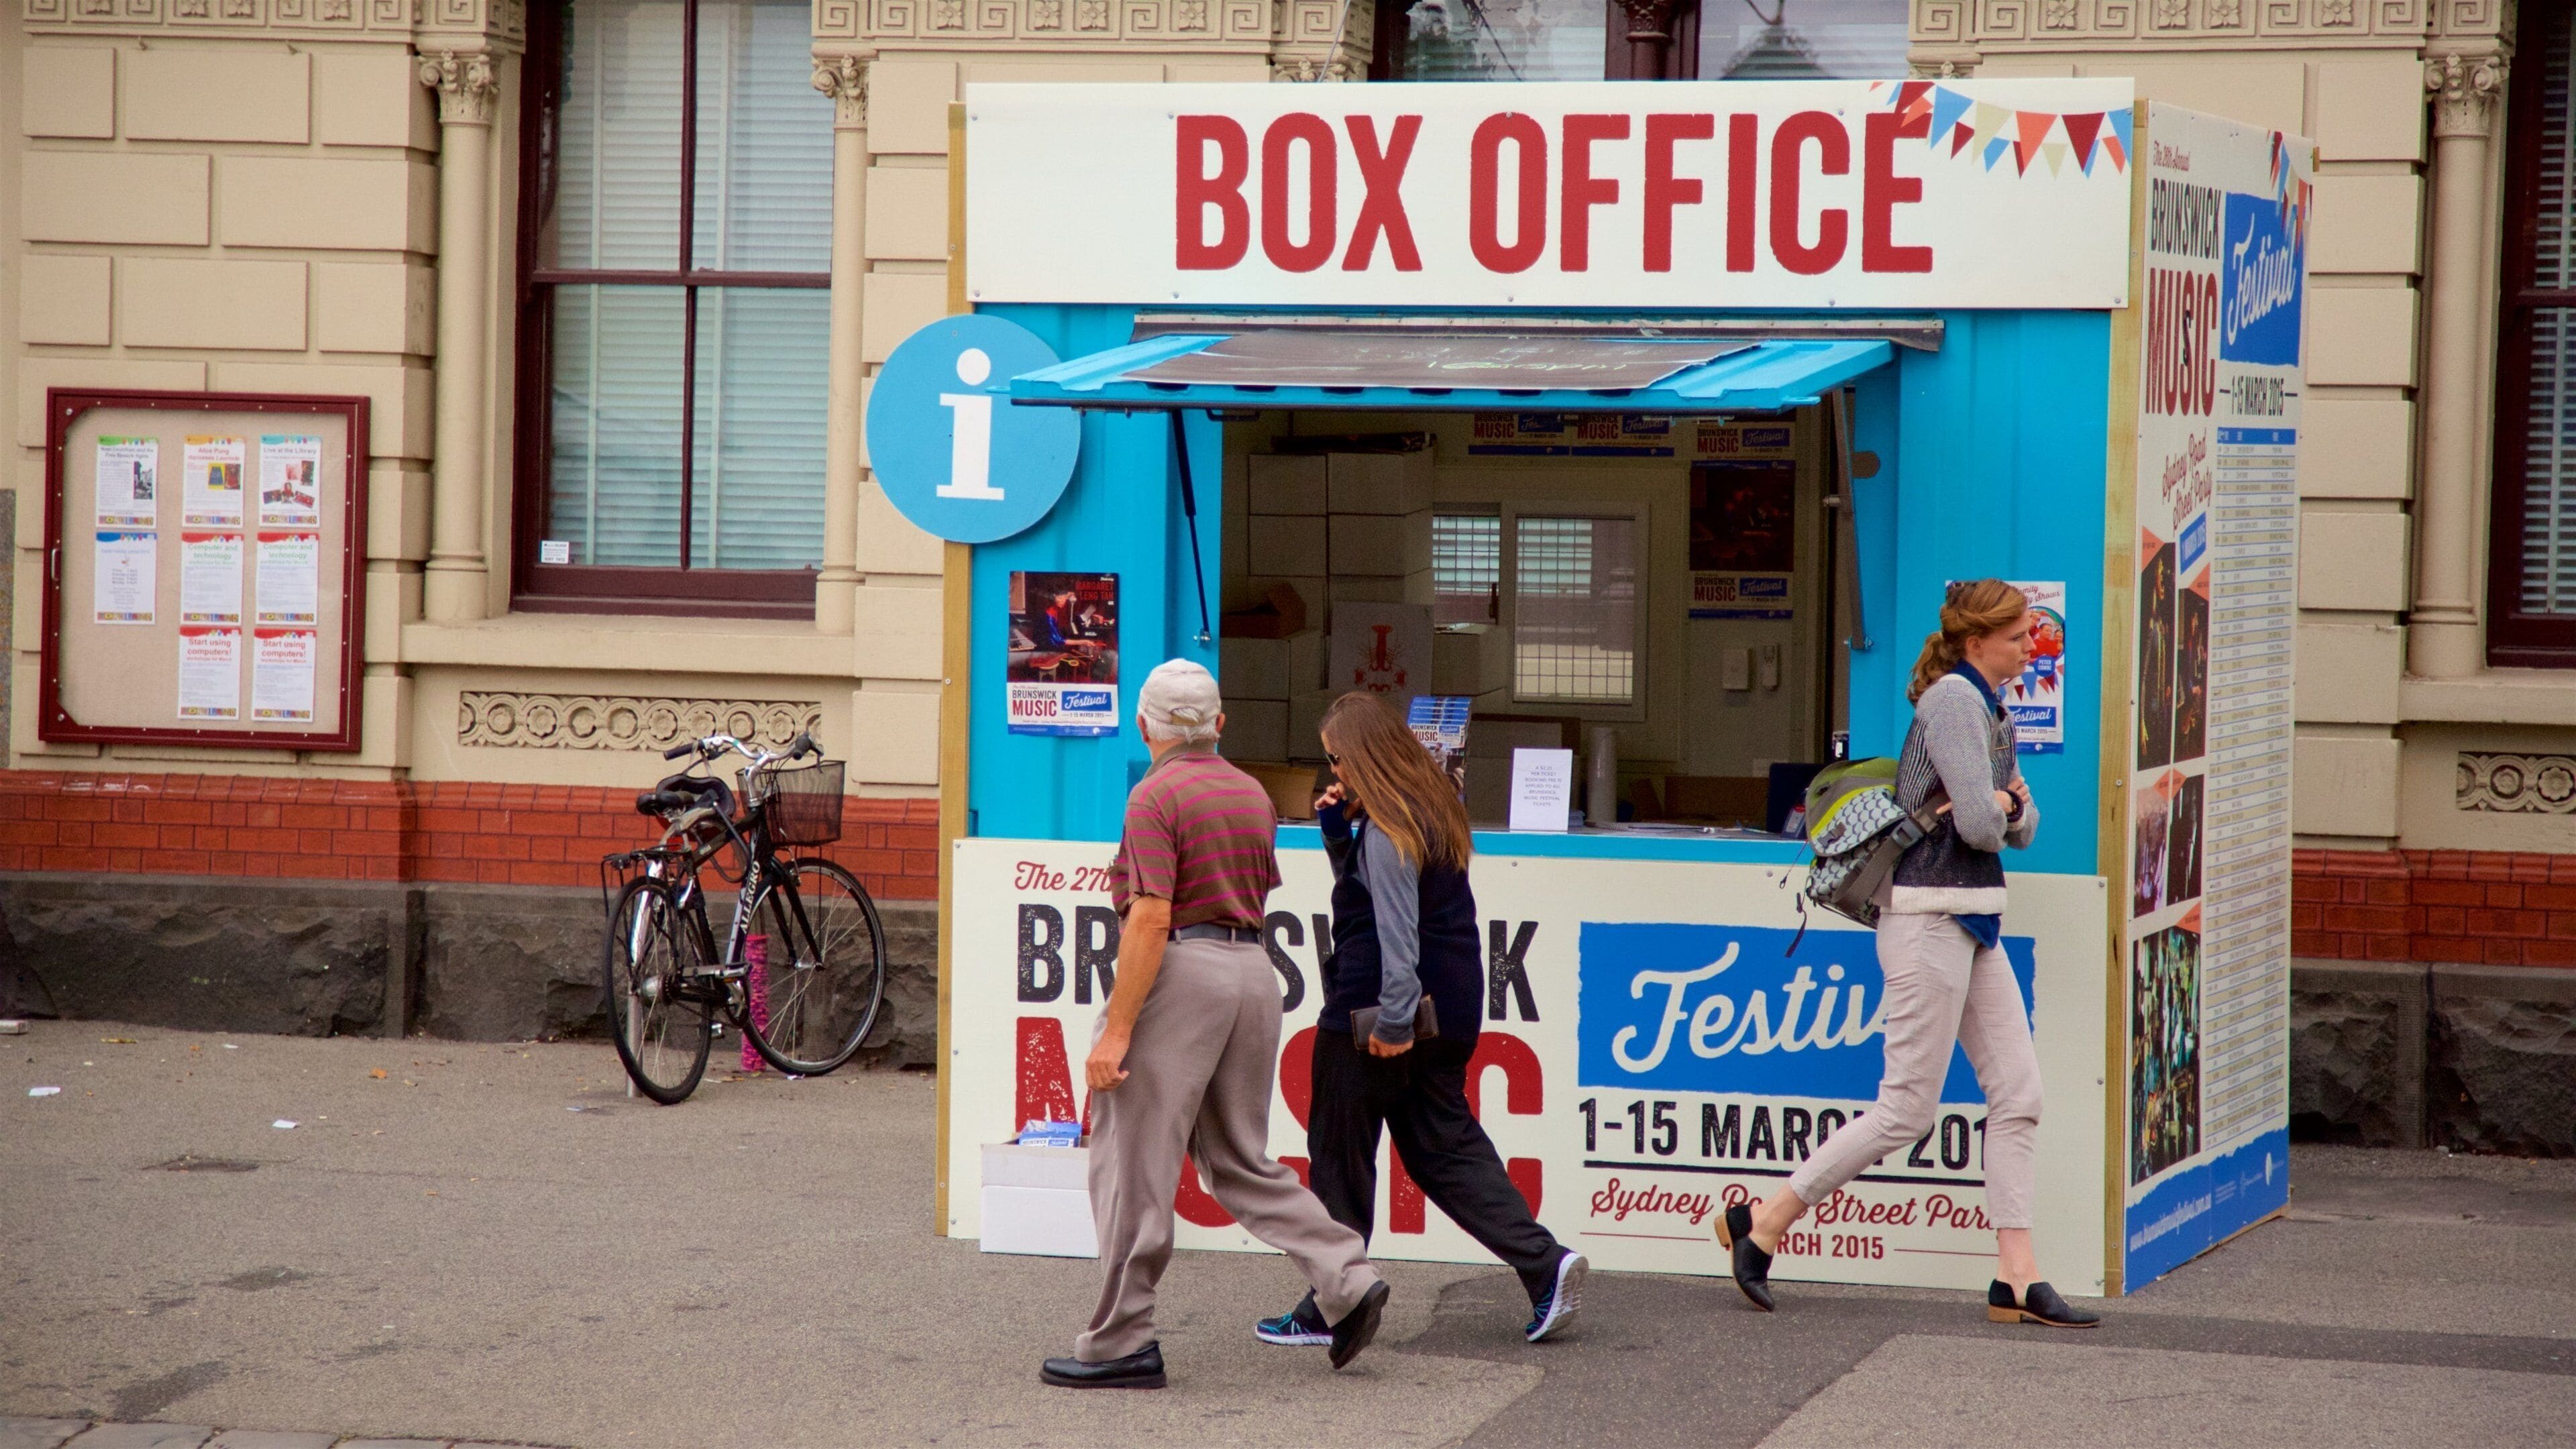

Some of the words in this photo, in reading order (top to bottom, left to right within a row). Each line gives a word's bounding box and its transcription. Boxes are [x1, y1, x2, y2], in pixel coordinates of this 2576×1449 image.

[1177, 113, 1422, 272] BOX
[1470, 111, 1934, 274] OFFICE
[2151, 178, 2221, 260] BRUNSWICK
[2226, 212, 2298, 346] Festival
[2145, 267, 2218, 417] MUSIC
[2231, 376, 2244, 415] 1-15
[2245, 376, 2267, 415] MARCH
[2268, 377, 2284, 416] 2015
[1474, 423, 1514, 438] MUSIC
[1578, 424, 1618, 439] MUSIC
[1697, 428, 1739, 437] BRUNSWICK
[1746, 430, 1785, 445] Festival
[1697, 437, 1739, 453] MUSIC
[2162, 452, 2188, 505] Sydney
[2188, 427, 2207, 479] Road
[2173, 481, 2194, 538] Street
[2194, 466, 2212, 508] Party
[188, 543, 223, 551] Computer
[263, 543, 297, 551] Computer
[193, 552, 232, 560] technology
[268, 551, 307, 560] technology
[1075, 581, 1114, 591] MARGARET
[1695, 577, 1735, 586] BRUNSWICK
[1742, 580, 1783, 595] Festival
[1079, 591, 1098, 600] LENG
[1100, 591, 1114, 600] TAN
[1695, 586, 1736, 601] MUSIC
[2018, 585, 2038, 594] amily
[2035, 591, 2060, 602] Shows
[209, 639, 231, 647] using
[284, 641, 306, 649] using
[262, 650, 307, 658] computers!
[1012, 690, 1057, 699] BRUNSWICK
[1065, 693, 1107, 710] Festival
[1012, 700, 1057, 716] MUSIC
[1014, 861, 1067, 891] The
[1070, 866, 1112, 892] 27t
[739, 861, 761, 934] ALLEGRO
[1611, 941, 1890, 1073] Festiv
[1578, 1097, 1678, 1156] 1-15
[1702, 1102, 1884, 1166] MARC
[1591, 1177, 1714, 1225] Sydney
[1814, 1189, 1918, 1230] Street
[1925, 1193, 1994, 1230] Par
[1777, 1230, 1822, 1256] RCH
[1831, 1234, 1884, 1260] 2015
